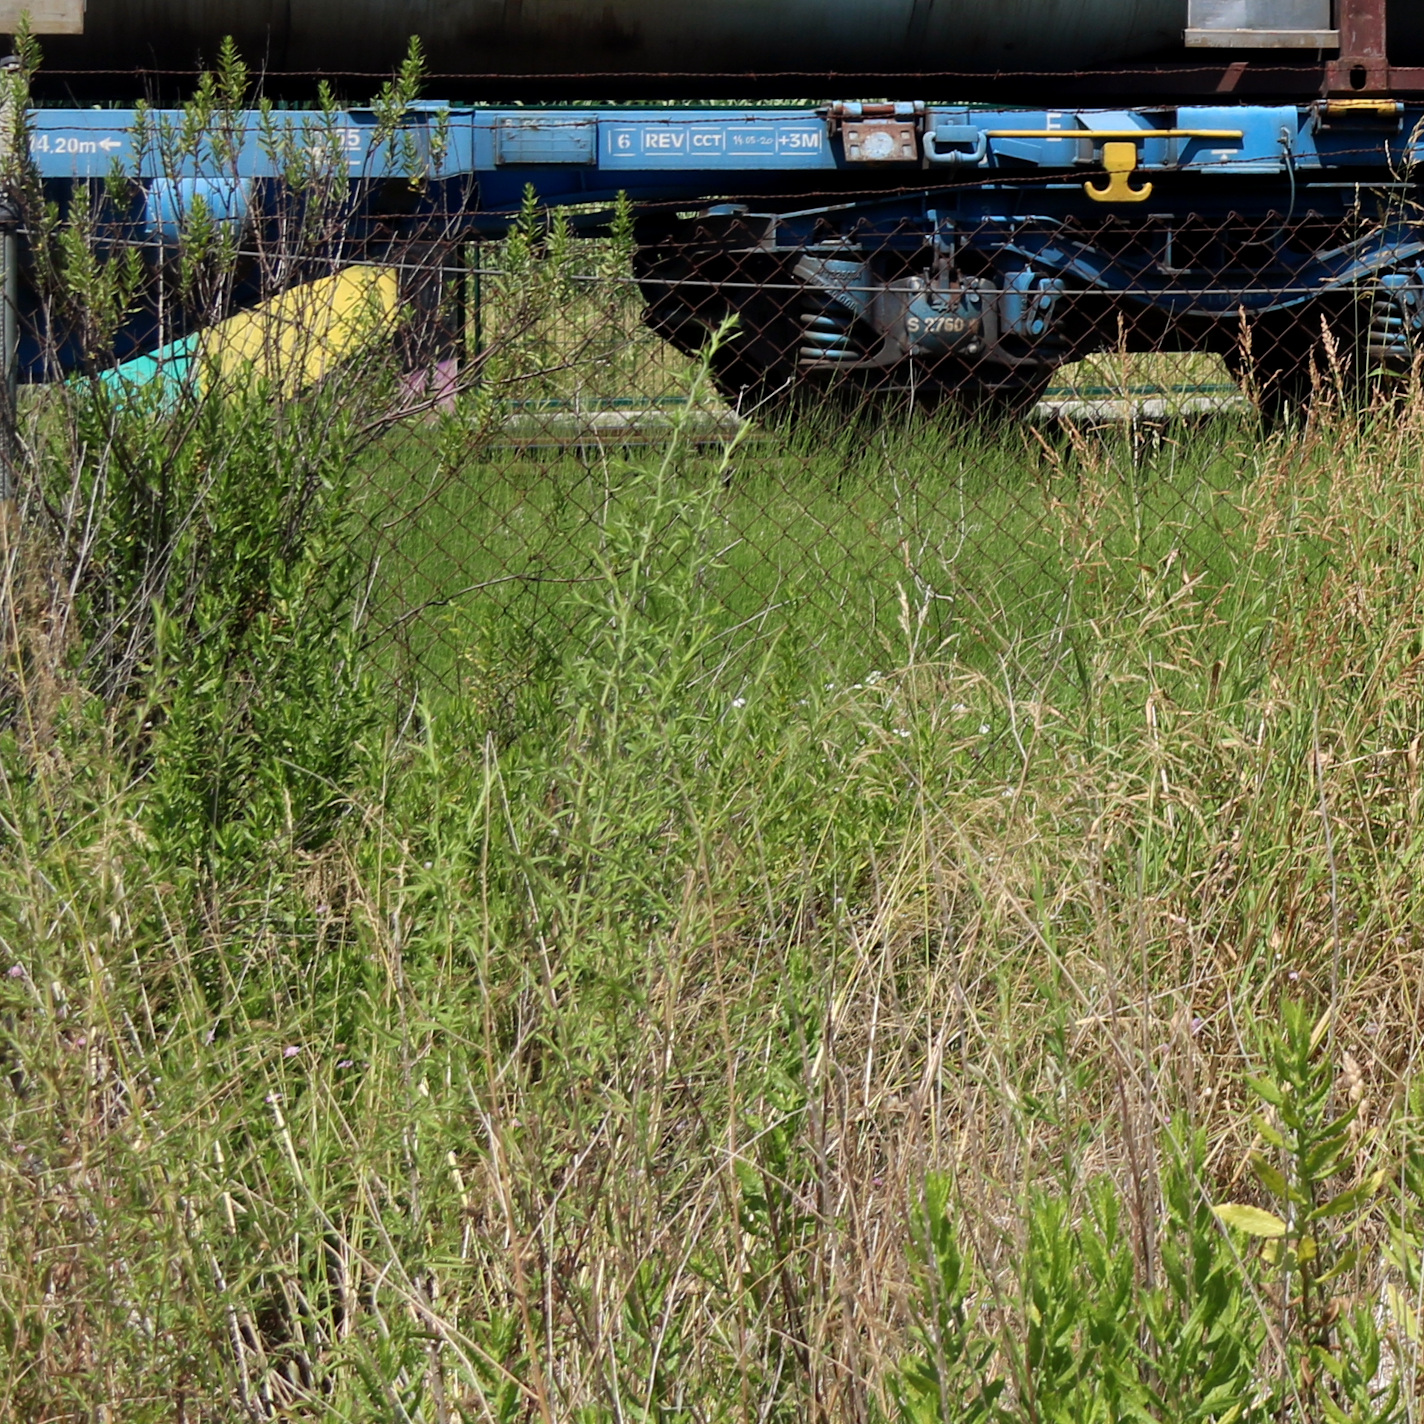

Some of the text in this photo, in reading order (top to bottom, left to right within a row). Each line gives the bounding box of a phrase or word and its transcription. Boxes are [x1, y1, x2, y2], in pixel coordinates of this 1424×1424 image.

[617, 134, 630, 149] 6
[646, 133, 684, 147] REV
[693, 134, 722, 147] CCT
[778, 133, 819, 148] +3M
[907, 318, 920, 333] S
